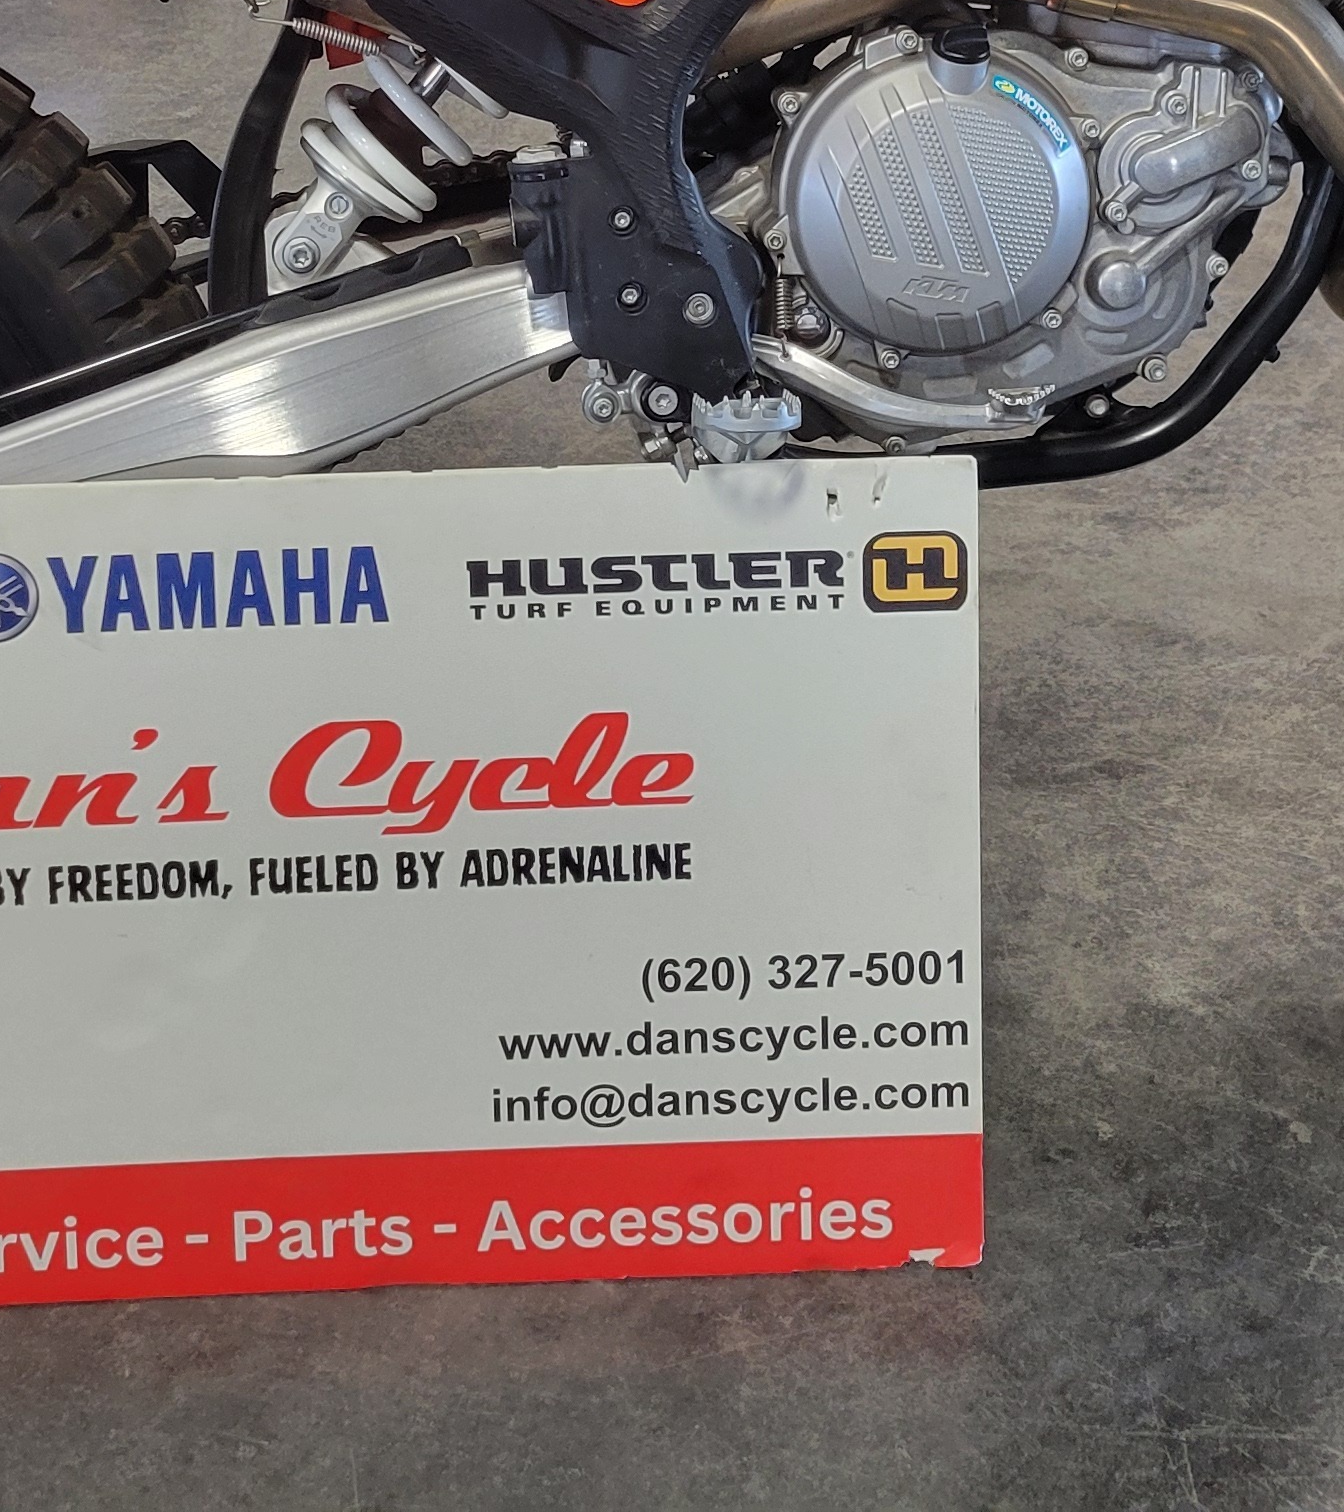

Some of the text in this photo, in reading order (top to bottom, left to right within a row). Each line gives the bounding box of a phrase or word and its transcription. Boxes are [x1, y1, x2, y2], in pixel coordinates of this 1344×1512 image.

[1015, 87, 1068, 149] MOTOREX
[47, 545, 390, 634] YAMAHA
[466, 550, 845, 598] HUSTLER
[470, 593, 846, 621] TURF EQUIPMENT
[268, 712, 696, 836] Cycle
[48, 859, 234, 906] FREEDOM,
[249, 853, 380, 896] FUELED
[395, 850, 445, 890] BY
[459, 842, 693, 888] ADRENALINE
[642, 949, 965, 1003] (620) 327-5001
[498, 1015, 970, 1062] www.danscycle.com
[492, 1076, 970, 1129] info@danscycle.com
[232, 1208, 414, 1262] Parts
[476, 1186, 895, 1253] Accessories
